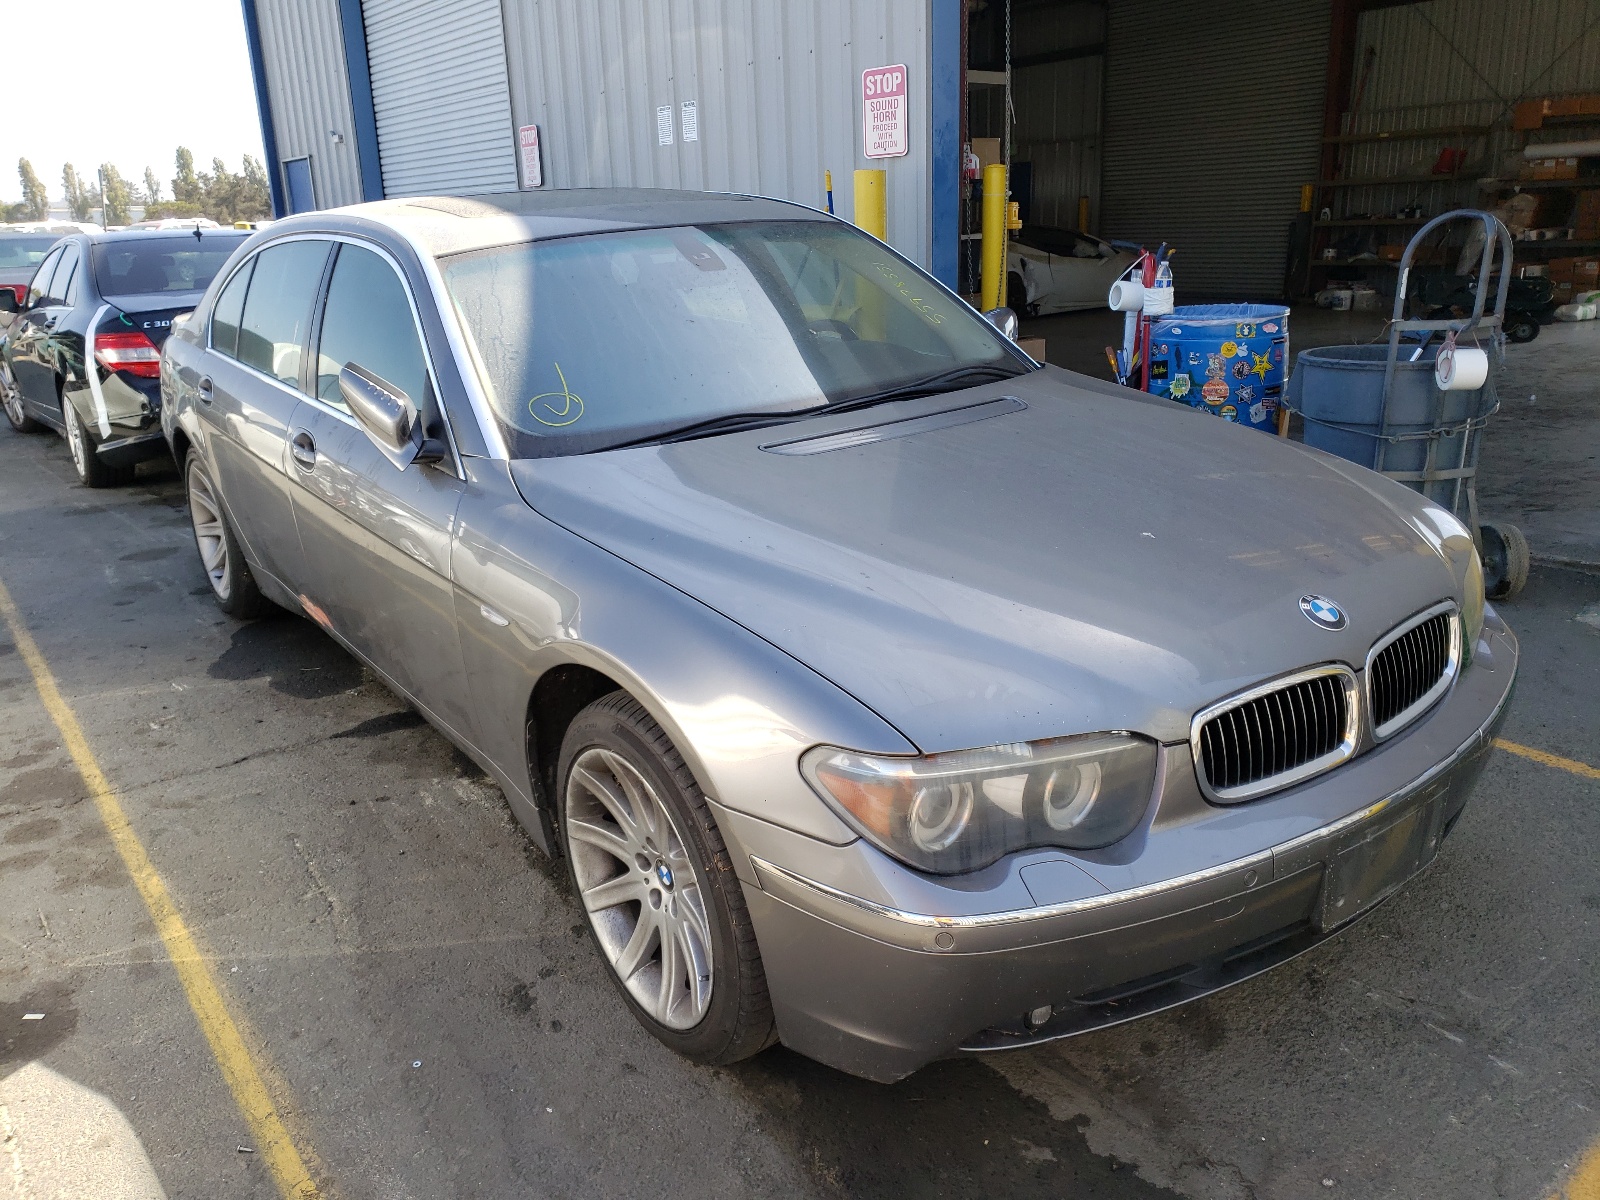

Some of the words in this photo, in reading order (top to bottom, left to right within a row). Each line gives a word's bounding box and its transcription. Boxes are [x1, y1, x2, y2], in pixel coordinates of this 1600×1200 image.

[866, 72, 902, 96] STOP
[870, 98, 899, 112] SOUND
[873, 110, 897, 123] HORN
[872, 122, 898, 132] PROCEED
[521, 130, 536, 145] STOP
[877, 131, 893, 140] WITH
[873, 140, 898, 150] CAUTION
